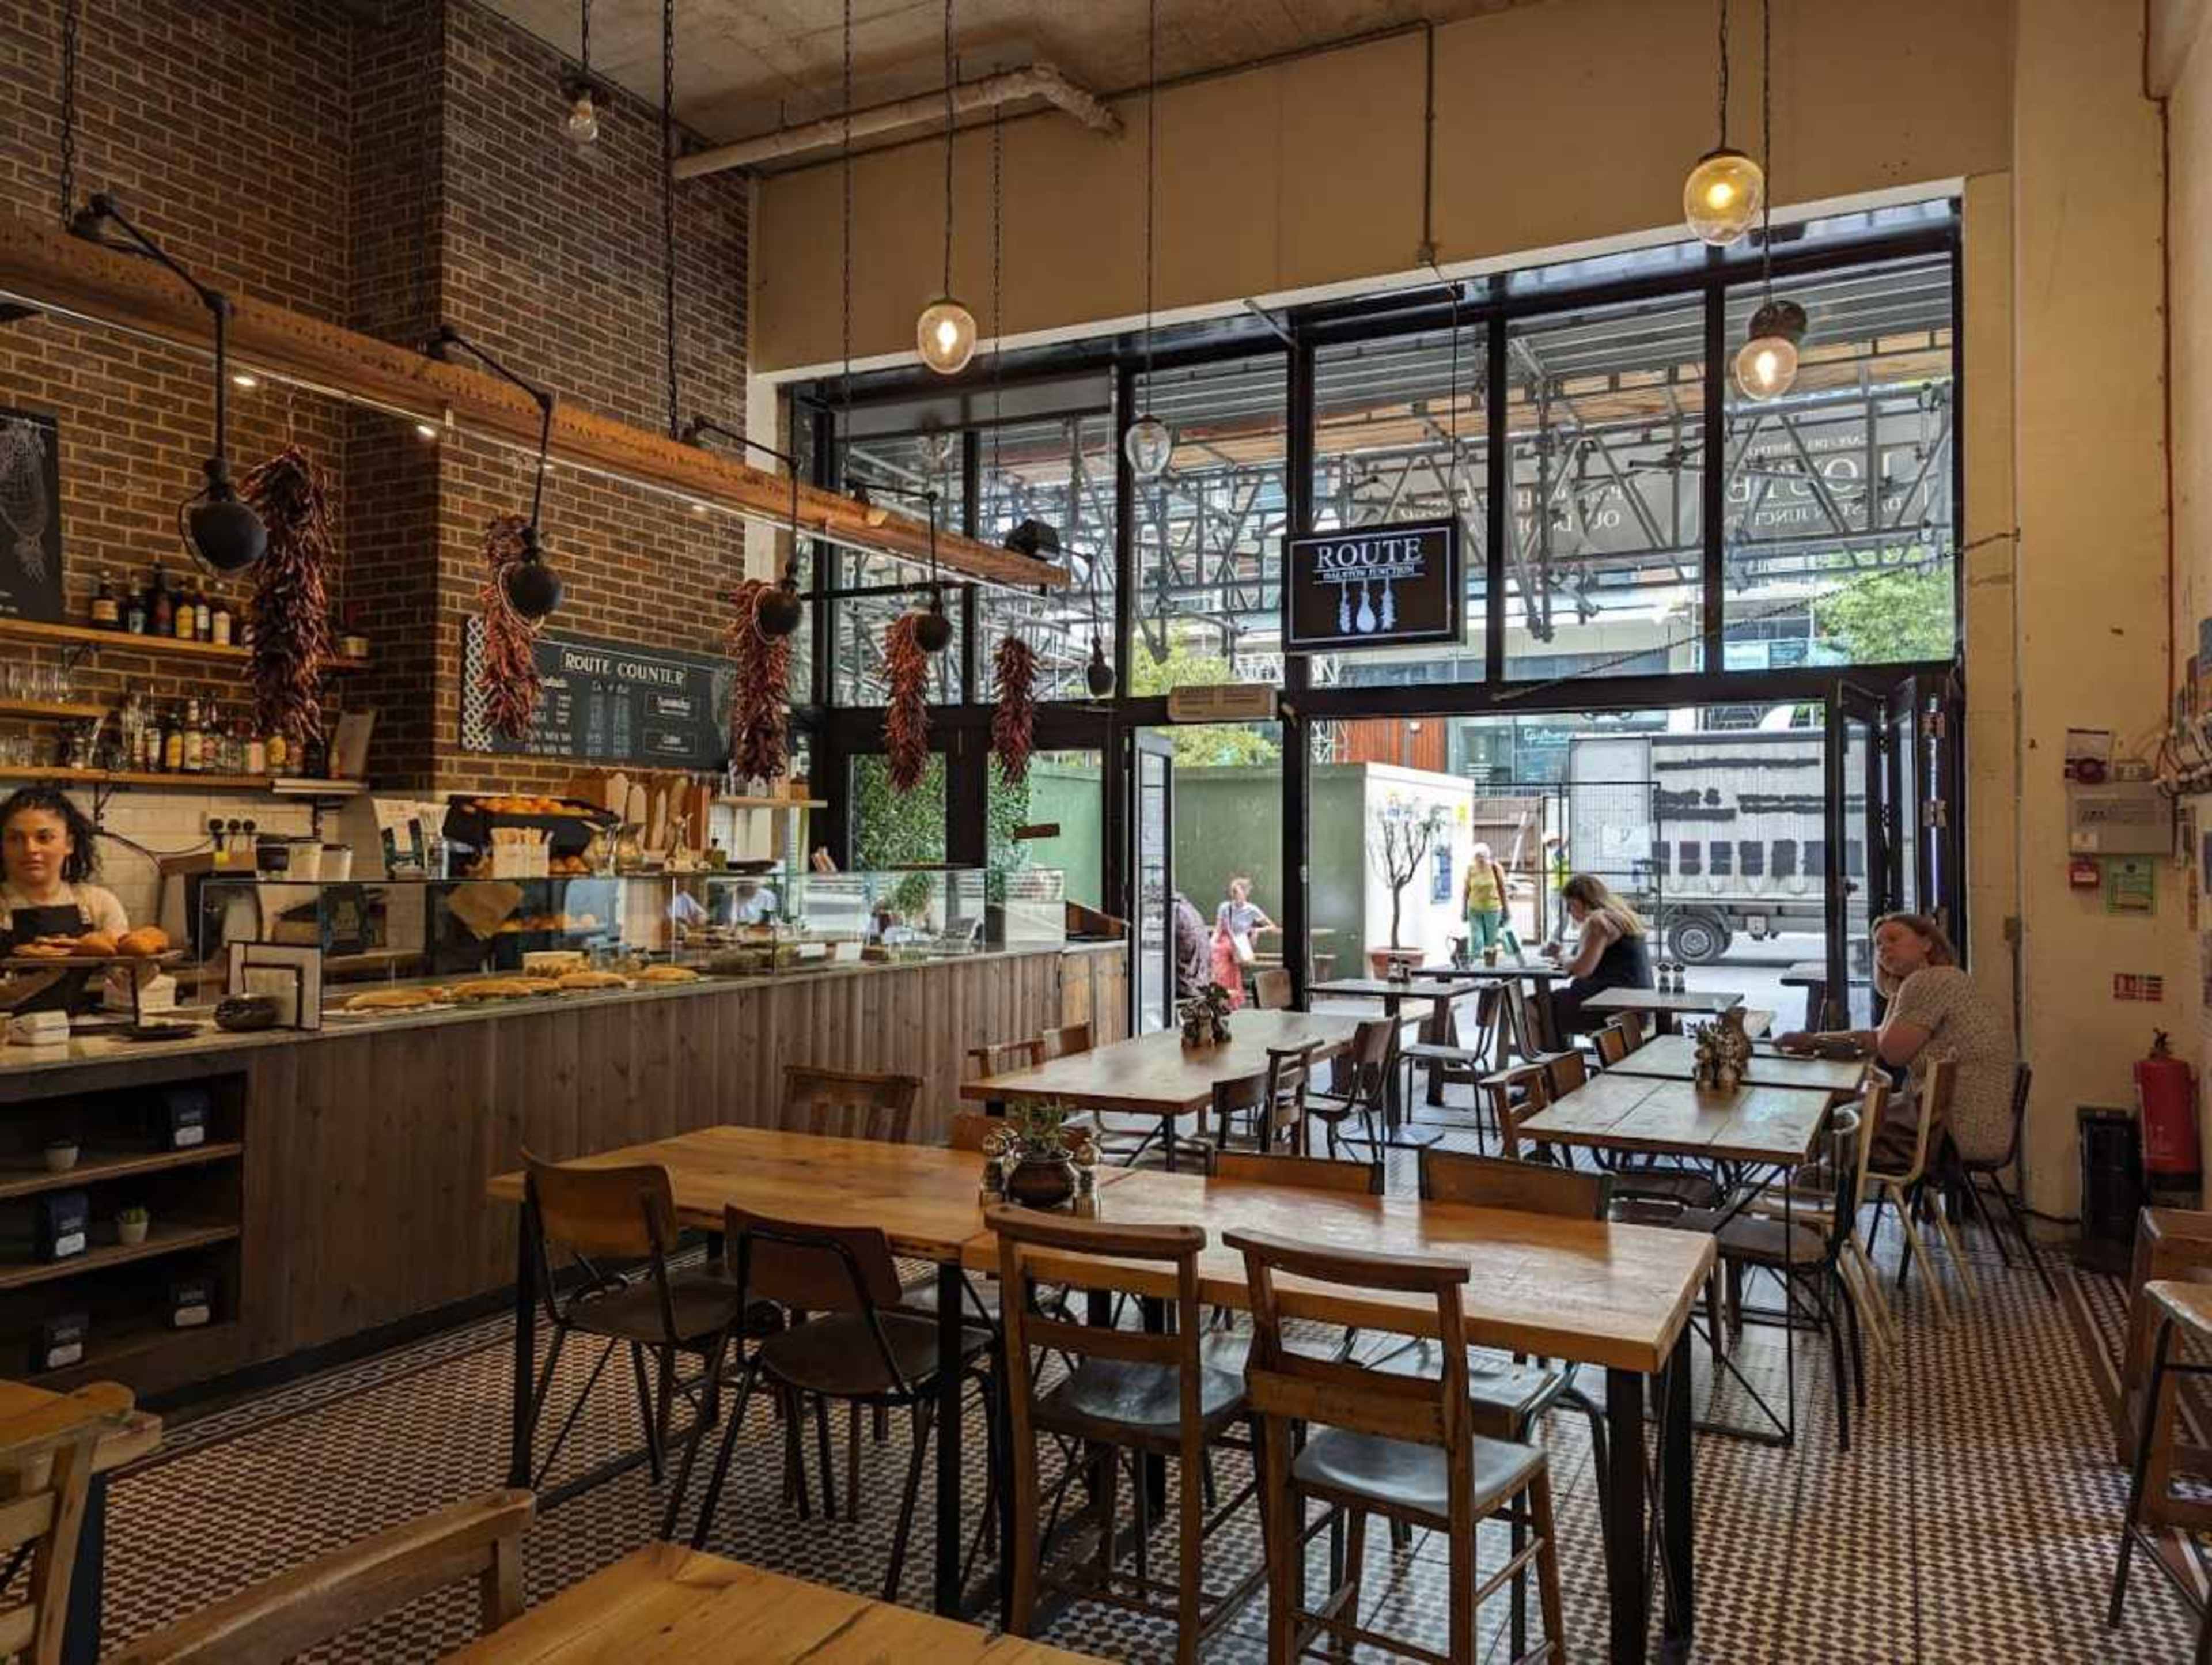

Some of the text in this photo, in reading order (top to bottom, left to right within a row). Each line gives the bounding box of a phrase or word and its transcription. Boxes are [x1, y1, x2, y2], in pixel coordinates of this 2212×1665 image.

[1317, 537, 1423, 569] ROUTE
[565, 652, 684, 685] ROUTE COUNTER
